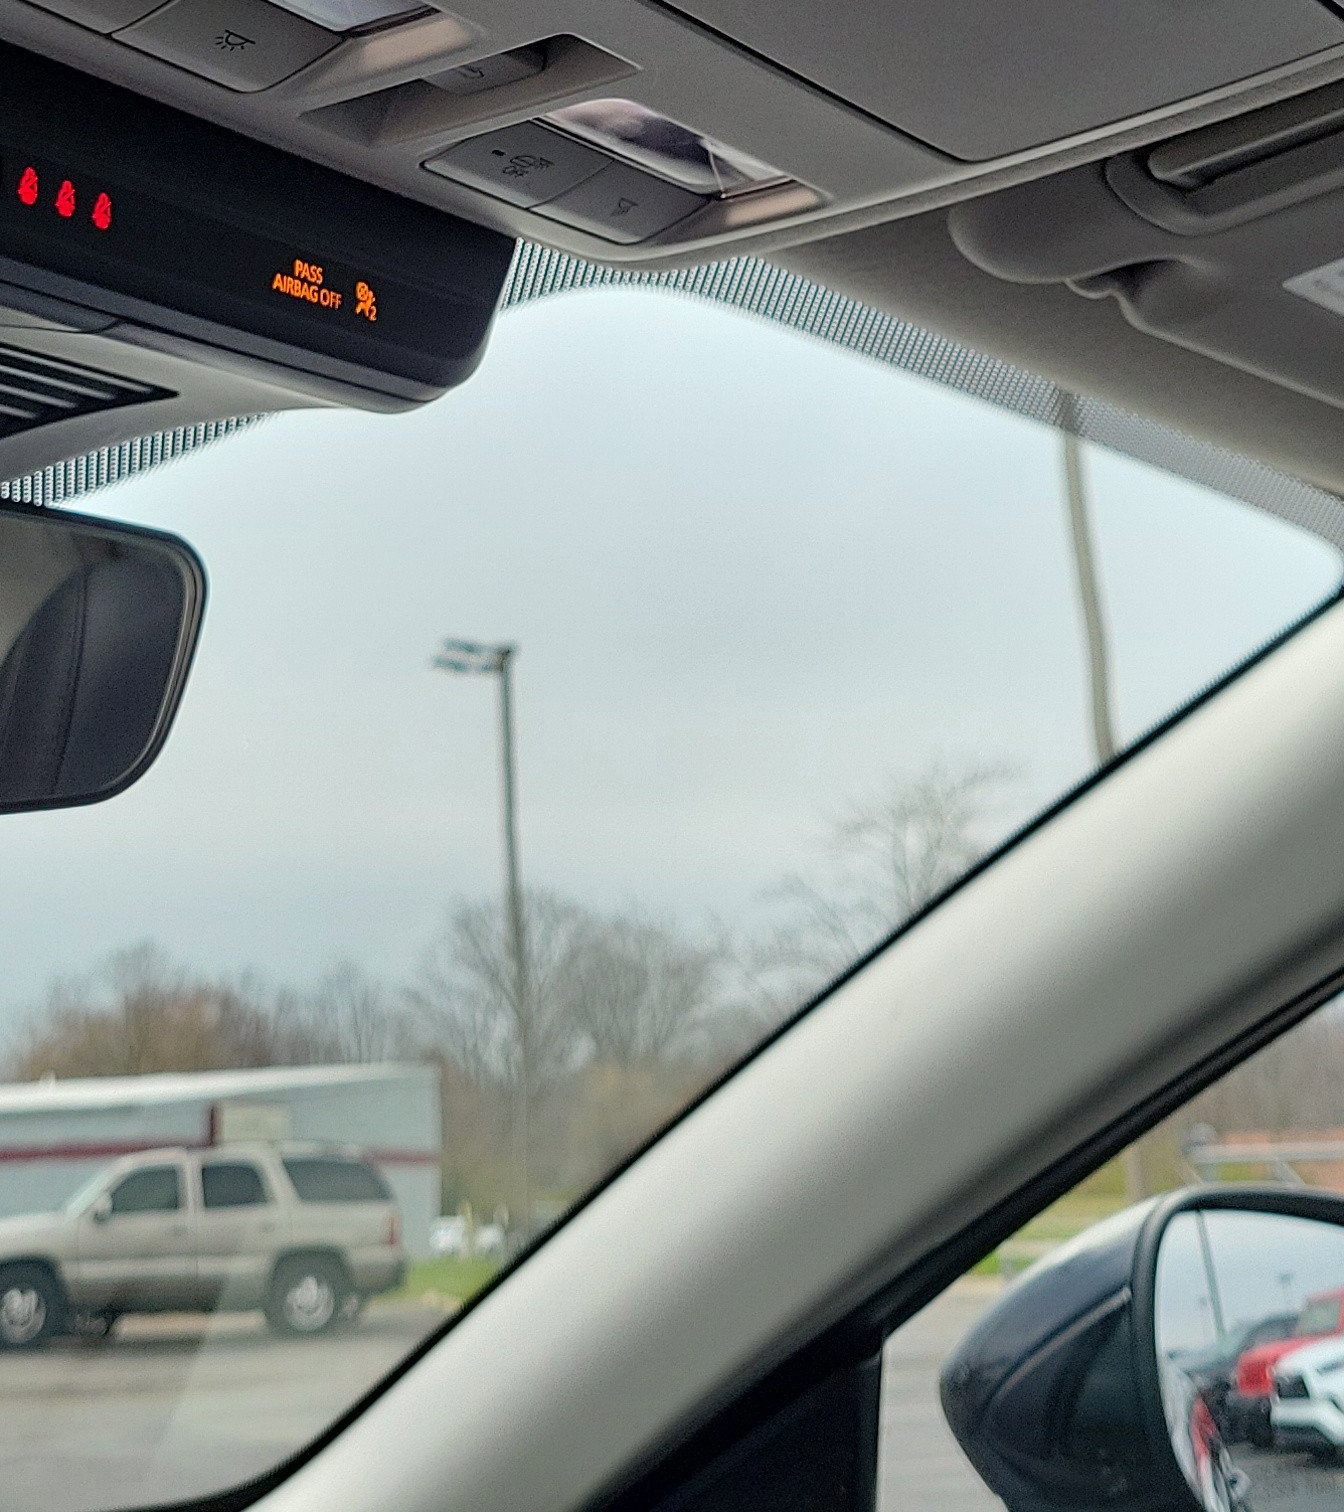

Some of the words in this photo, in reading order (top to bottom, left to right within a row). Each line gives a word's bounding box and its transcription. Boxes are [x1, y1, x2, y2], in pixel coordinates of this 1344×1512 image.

[294, 259, 323, 285] PASS
[272, 273, 319, 303] AIRBAG
[319, 289, 342, 309] OFF
